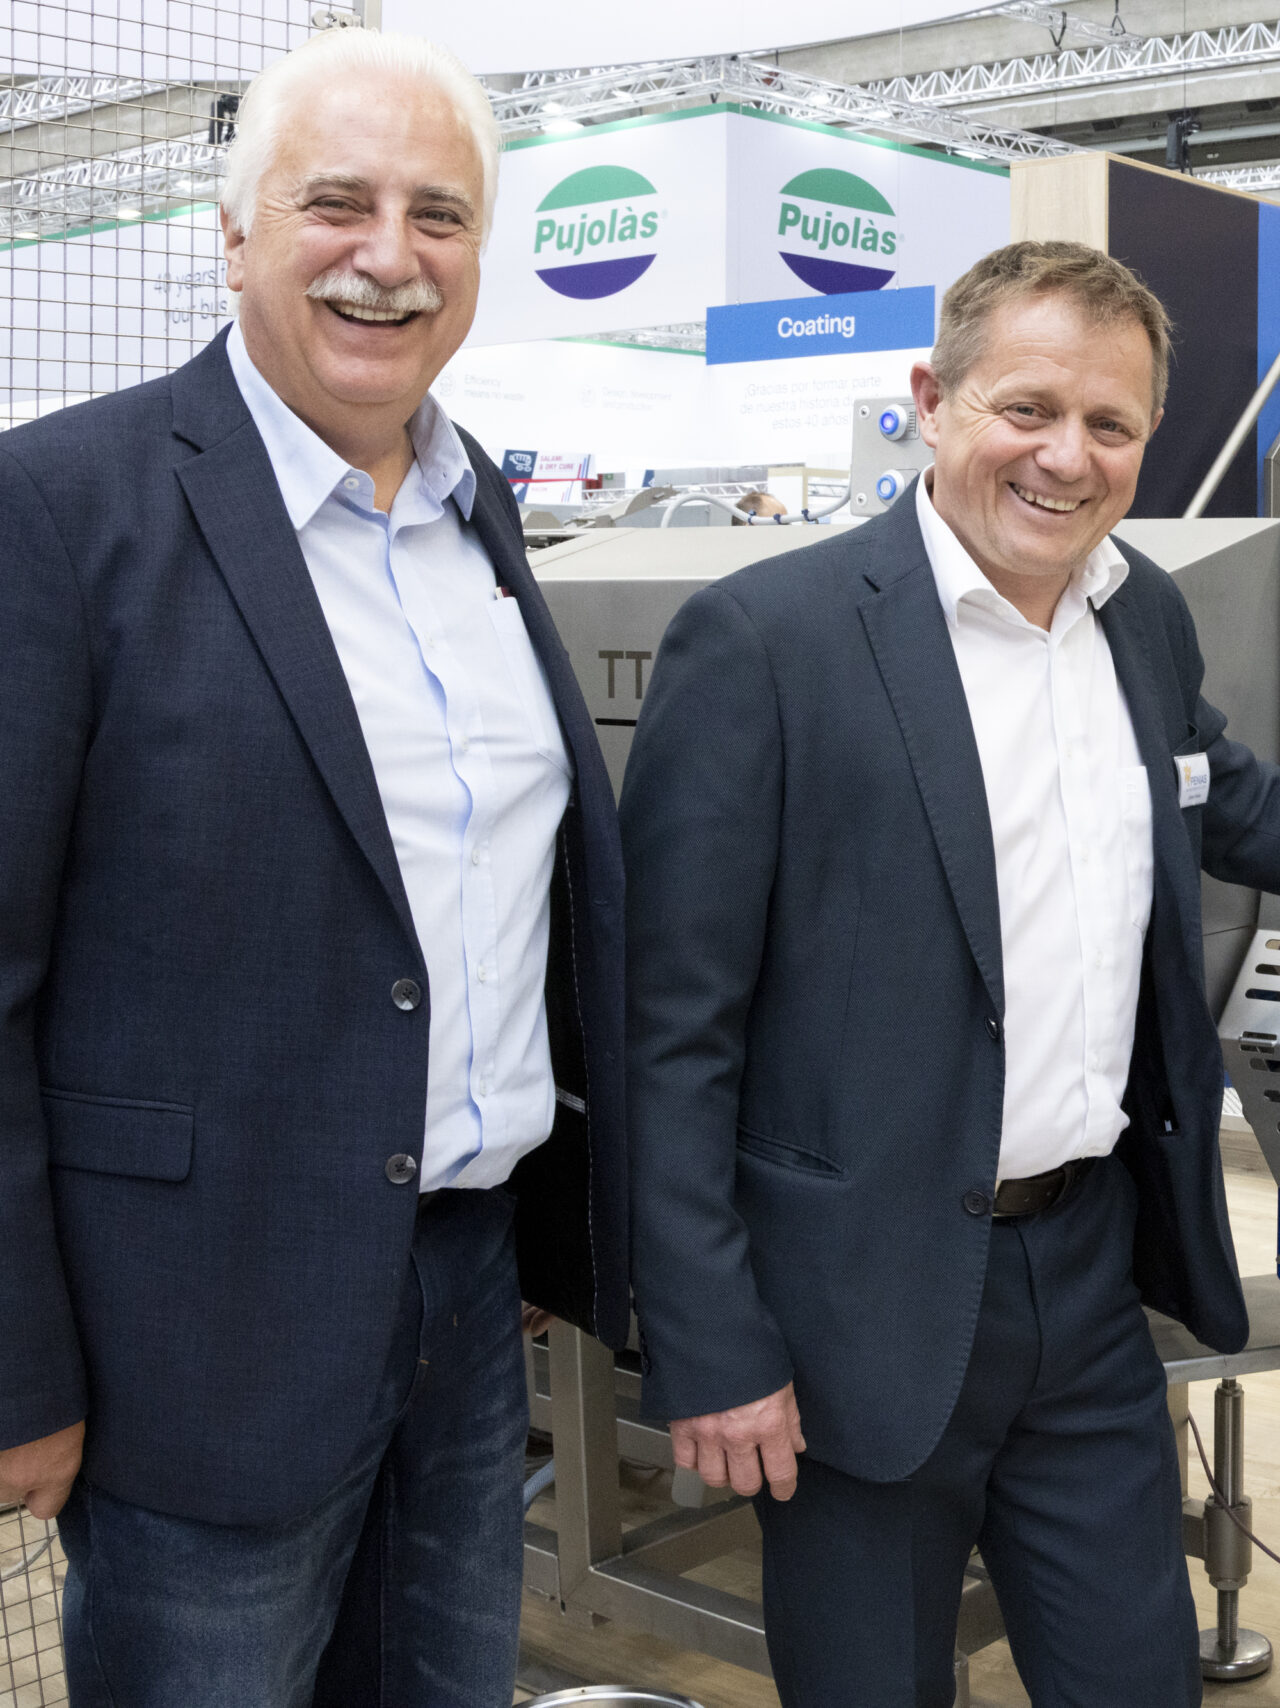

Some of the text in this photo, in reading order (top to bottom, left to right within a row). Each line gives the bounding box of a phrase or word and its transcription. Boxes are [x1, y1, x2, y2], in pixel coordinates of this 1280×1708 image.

[534, 206, 658, 256] Pujolàs
[778, 201, 897, 256] Pujolàs
[777, 313, 855, 339] Coating
[598, 650, 652, 700] TT
